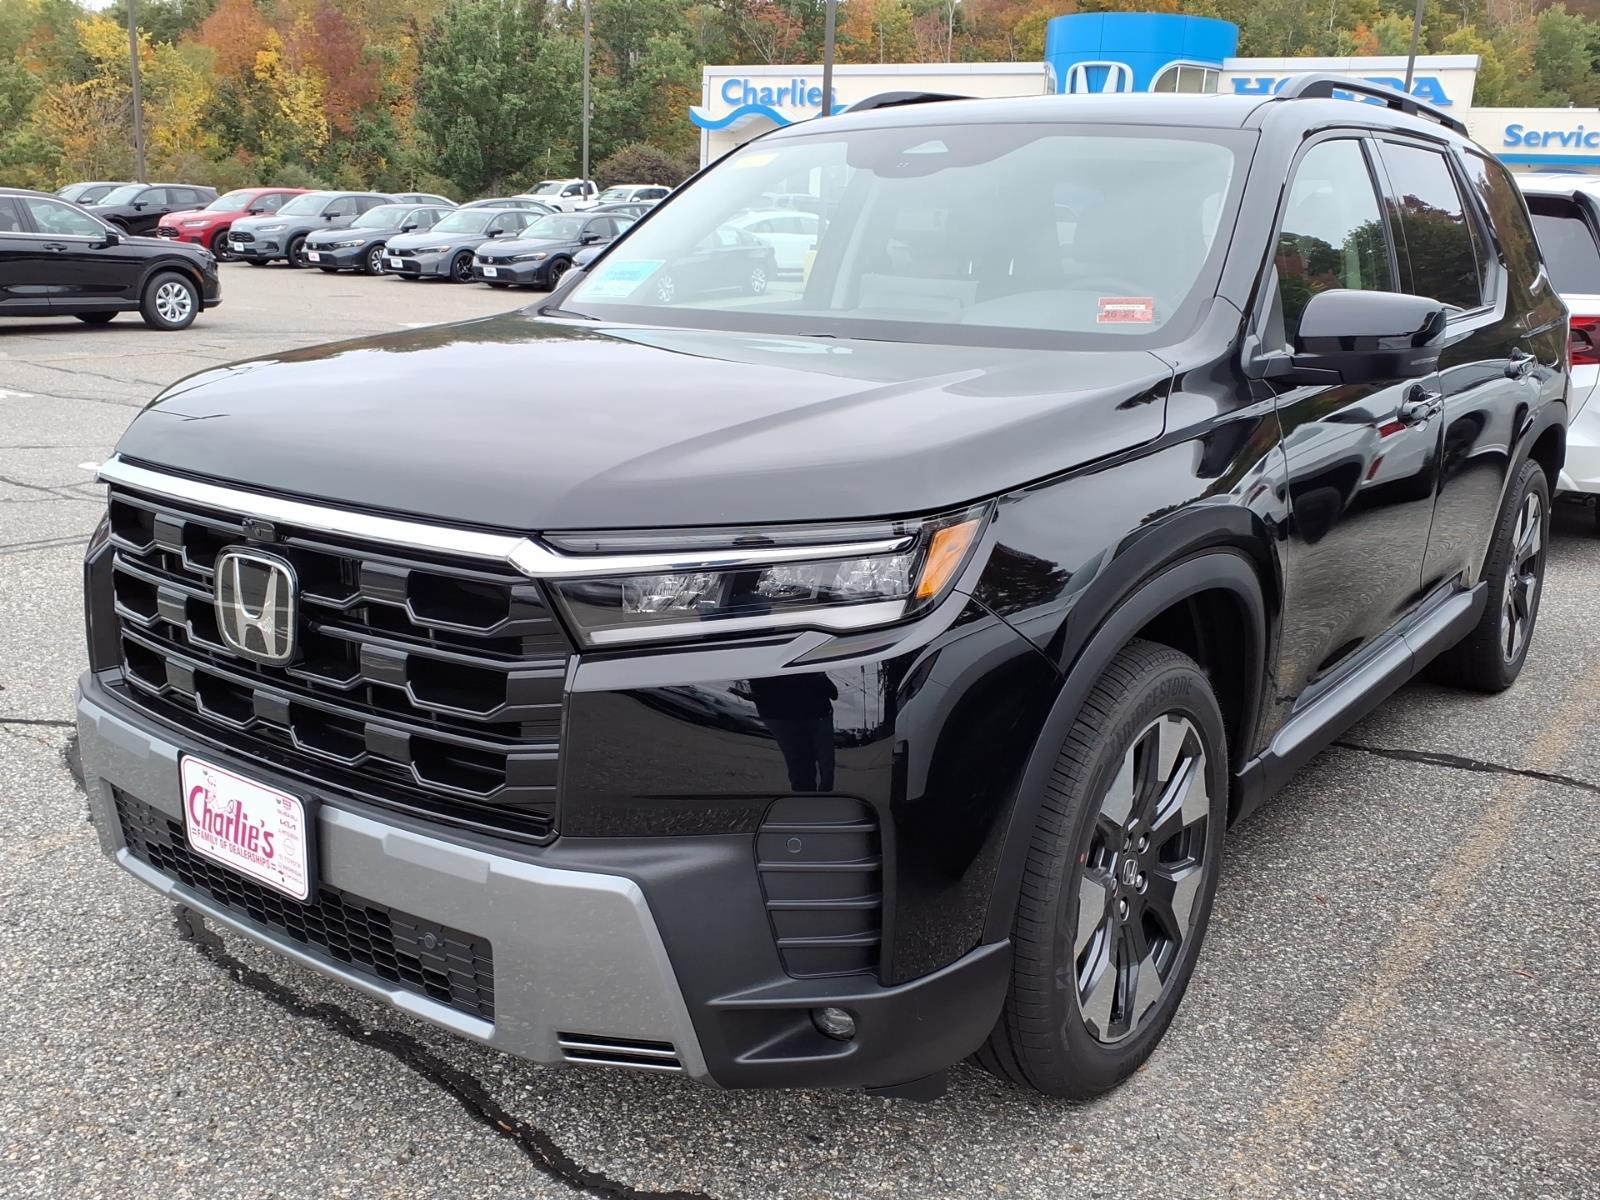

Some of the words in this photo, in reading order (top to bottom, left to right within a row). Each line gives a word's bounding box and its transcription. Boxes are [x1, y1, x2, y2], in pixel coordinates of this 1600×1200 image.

[1231, 77, 1454, 106] HDA
[189, 785, 275, 859] Charlie's
[197, 828, 218, 846] FAMILY
[219, 839, 228, 849] OF
[228, 843, 271, 869] DEALERSHIPS
